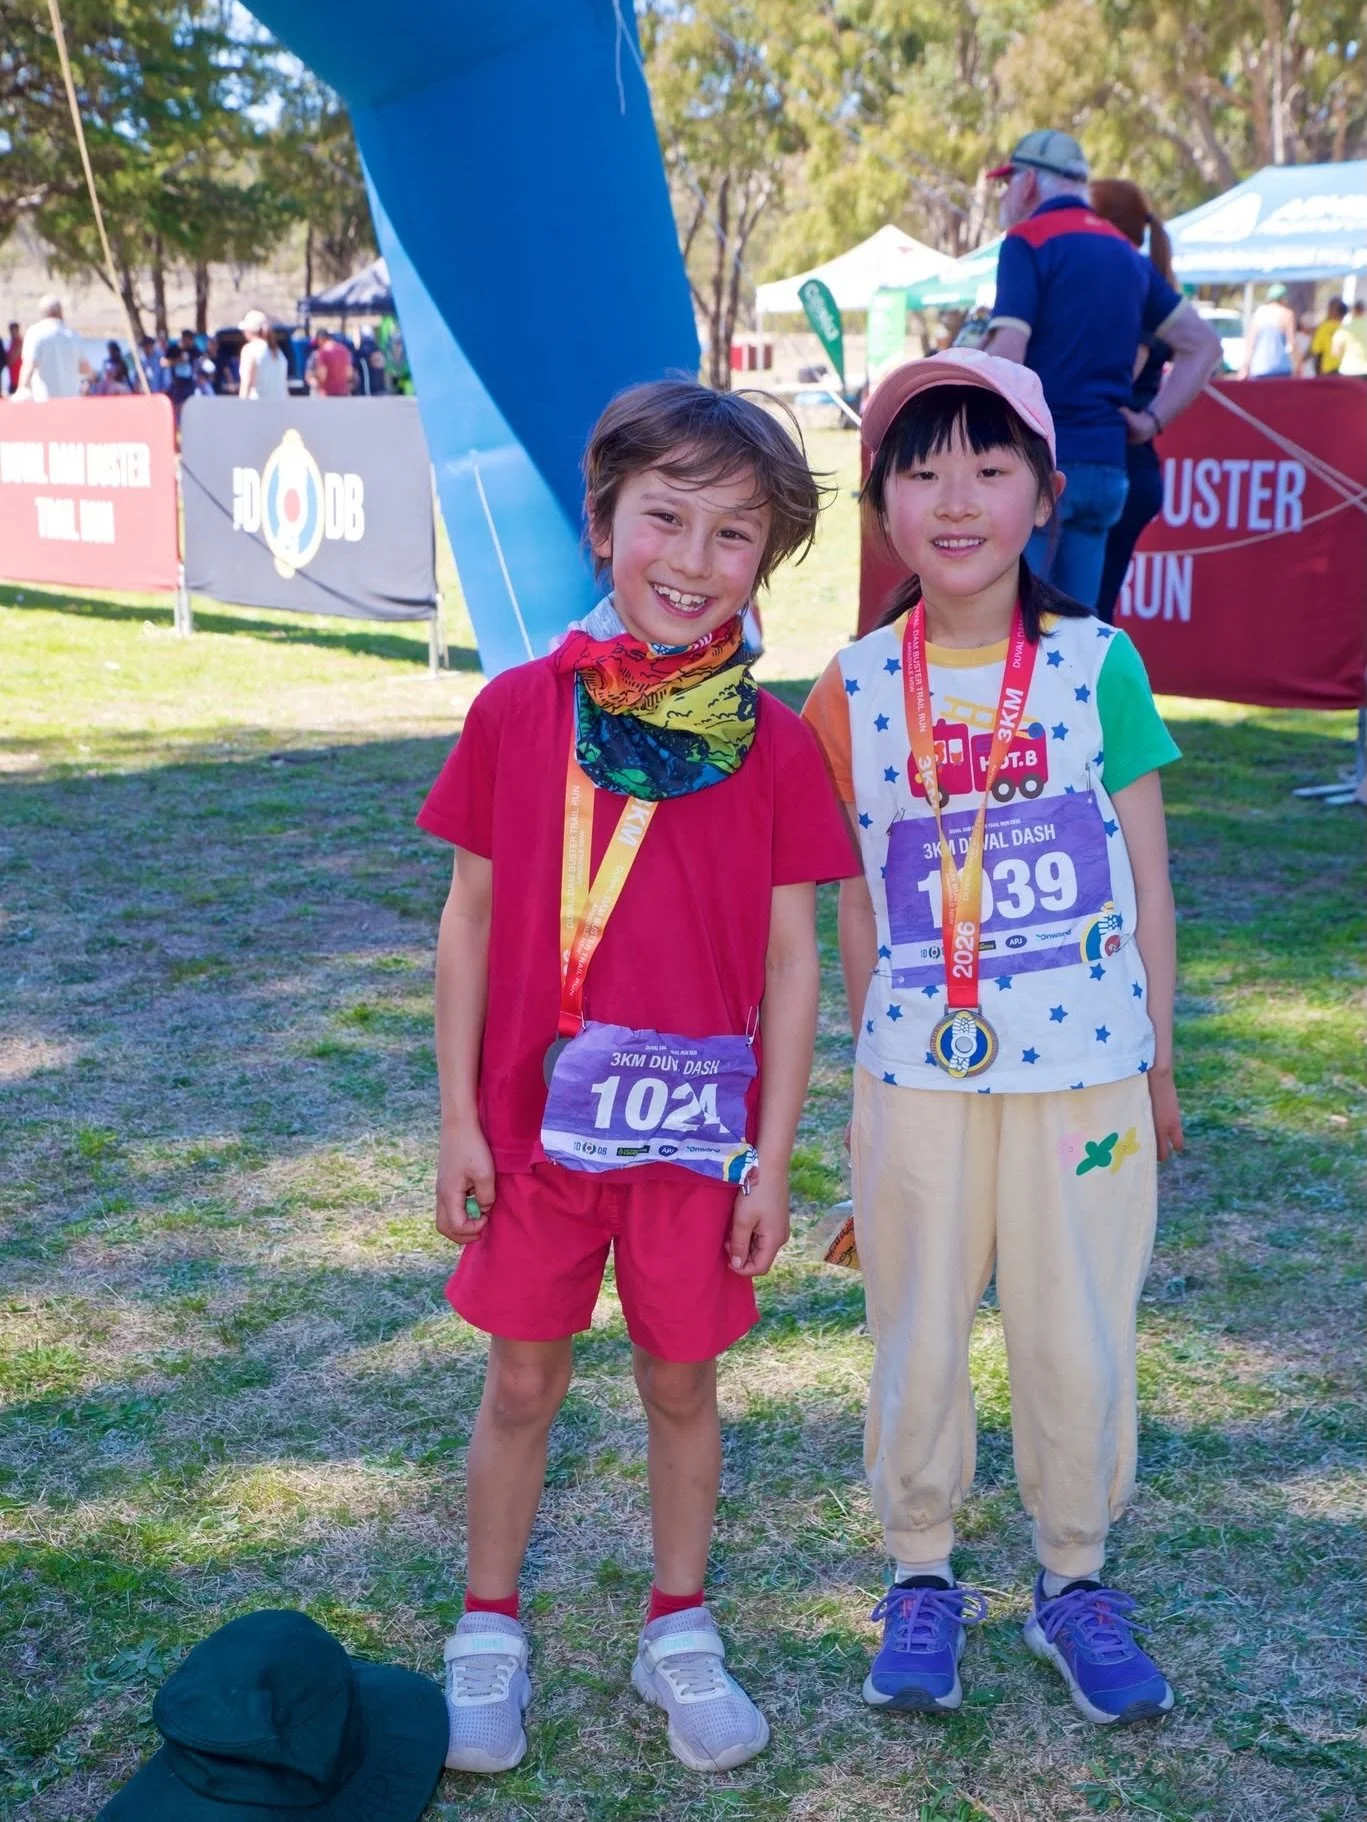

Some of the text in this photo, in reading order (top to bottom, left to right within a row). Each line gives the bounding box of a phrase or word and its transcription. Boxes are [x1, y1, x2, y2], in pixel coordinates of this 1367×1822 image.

[86, 442, 151, 488] BUSTER
[1163, 457, 1306, 533] USTER
[912, 651, 921, 684] BUSTER
[1012, 640, 1024, 669] DUVAL
[915, 687, 924, 711] TRAIL
[918, 713, 926, 732] RUN
[998, 687, 1024, 743] 3KM
[570, 785, 579, 805] RUN
[959, 832, 1008, 854] DVAL
[1012, 824, 1056, 846] DASH
[953, 921, 975, 979] 2026
[610, 1052, 647, 1067] 3KM
[683, 1060, 720, 1075] DASH
